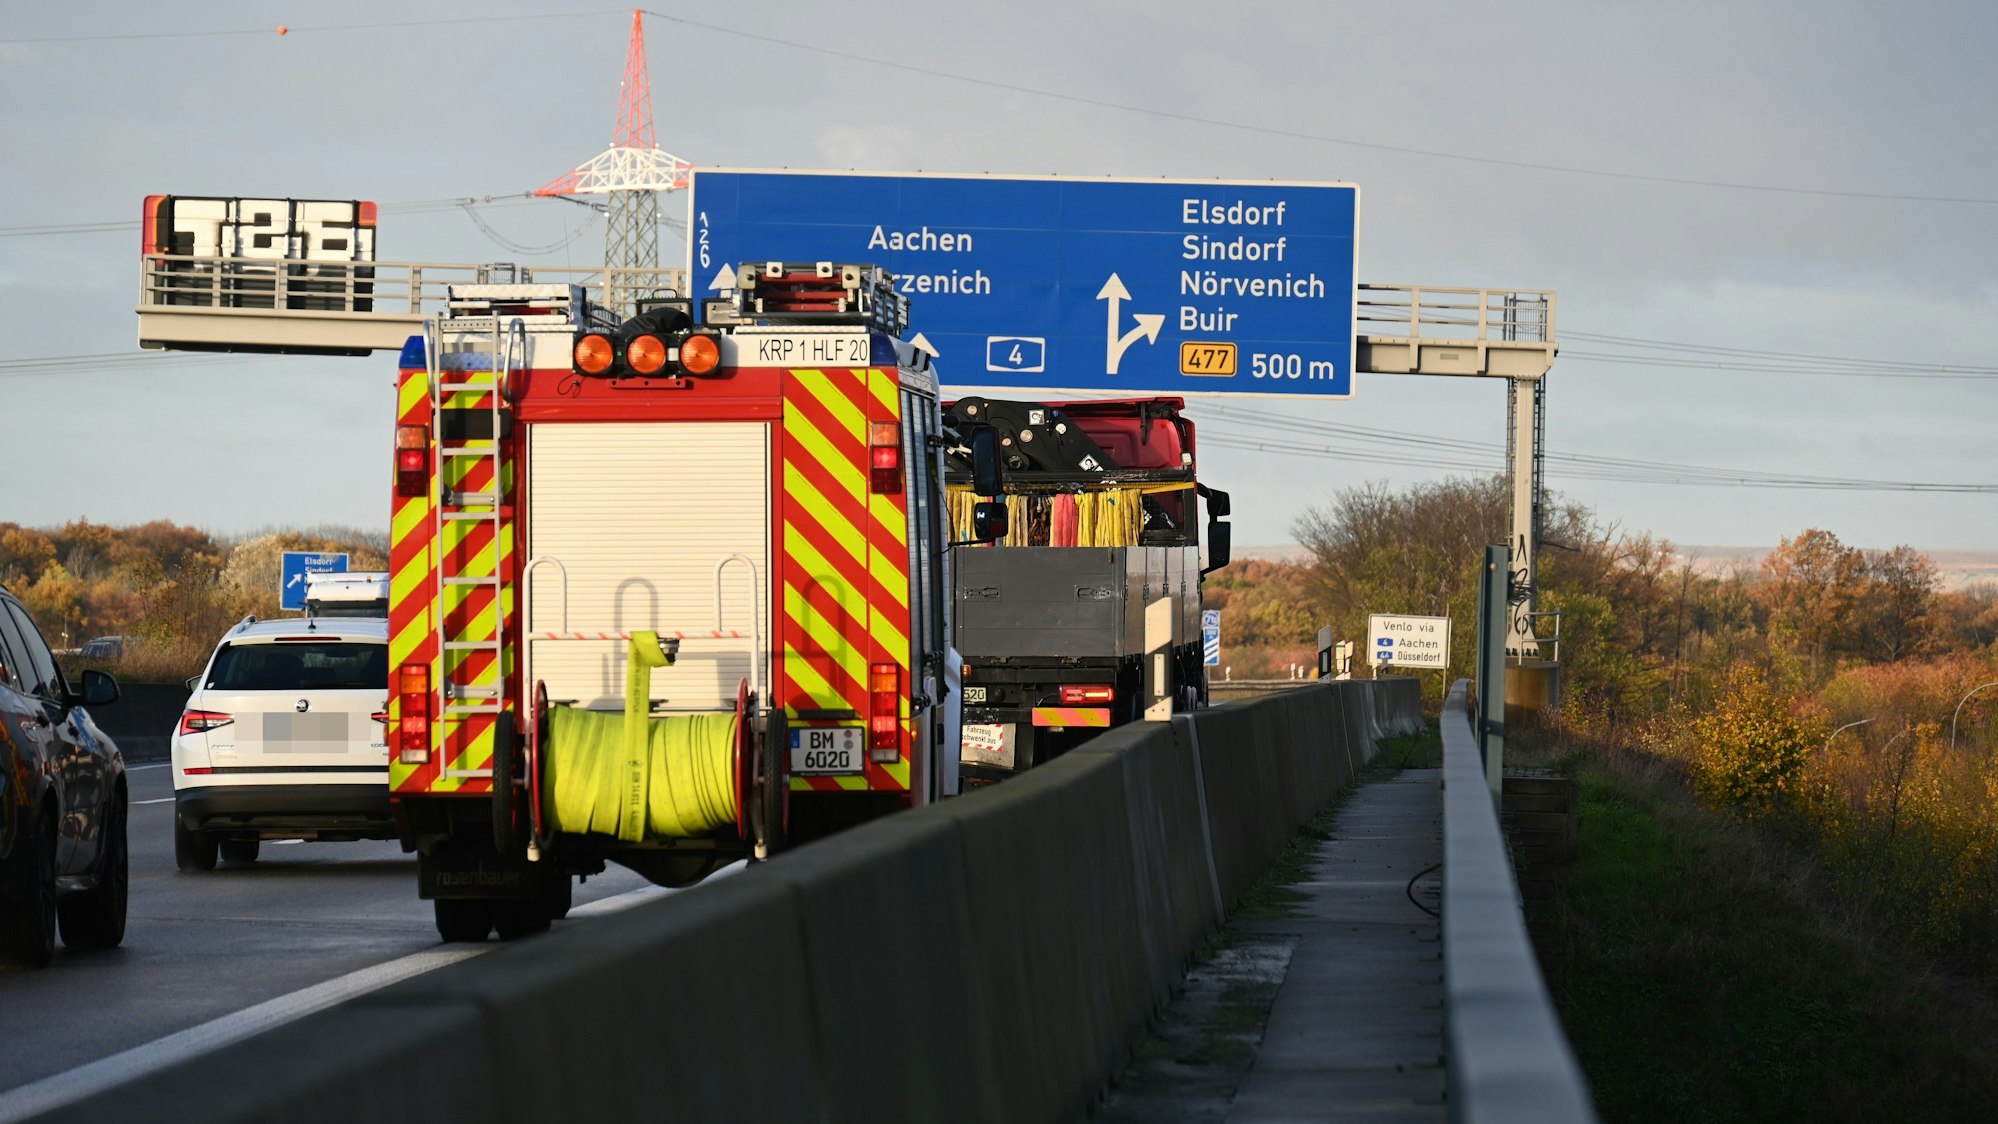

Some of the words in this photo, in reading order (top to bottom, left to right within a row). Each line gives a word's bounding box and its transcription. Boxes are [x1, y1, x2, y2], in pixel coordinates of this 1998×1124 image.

[1182, 198, 1286, 226] Elsdorf
[699, 211, 711, 269] 126
[867, 224, 973, 252] Aachen
[1182, 234, 1287, 262] Sindorf
[891, 269, 991, 295] rzenich
[1180, 270, 1325, 298] Nörvenich
[1179, 305, 1239, 332] Buir
[759, 339, 794, 361] KRP
[799, 339, 805, 361] 1
[813, 339, 844, 361] HLF
[849, 339, 868, 361] 20
[1008, 343, 1023, 365] 4
[1188, 348, 1229, 369] 477
[1252, 353, 1302, 379] 500
[1309, 360, 1334, 380] m
[1383, 621, 1413, 632] Venlo
[1419, 623, 1435, 633] via
[1398, 638, 1438, 649] Aachen
[1397, 651, 1441, 662] Düsseldorf
[810, 731, 834, 749] BM
[966, 725, 992, 737] Fahrzeug
[987, 737, 997, 745] aus
[804, 751, 850, 769] 6020
